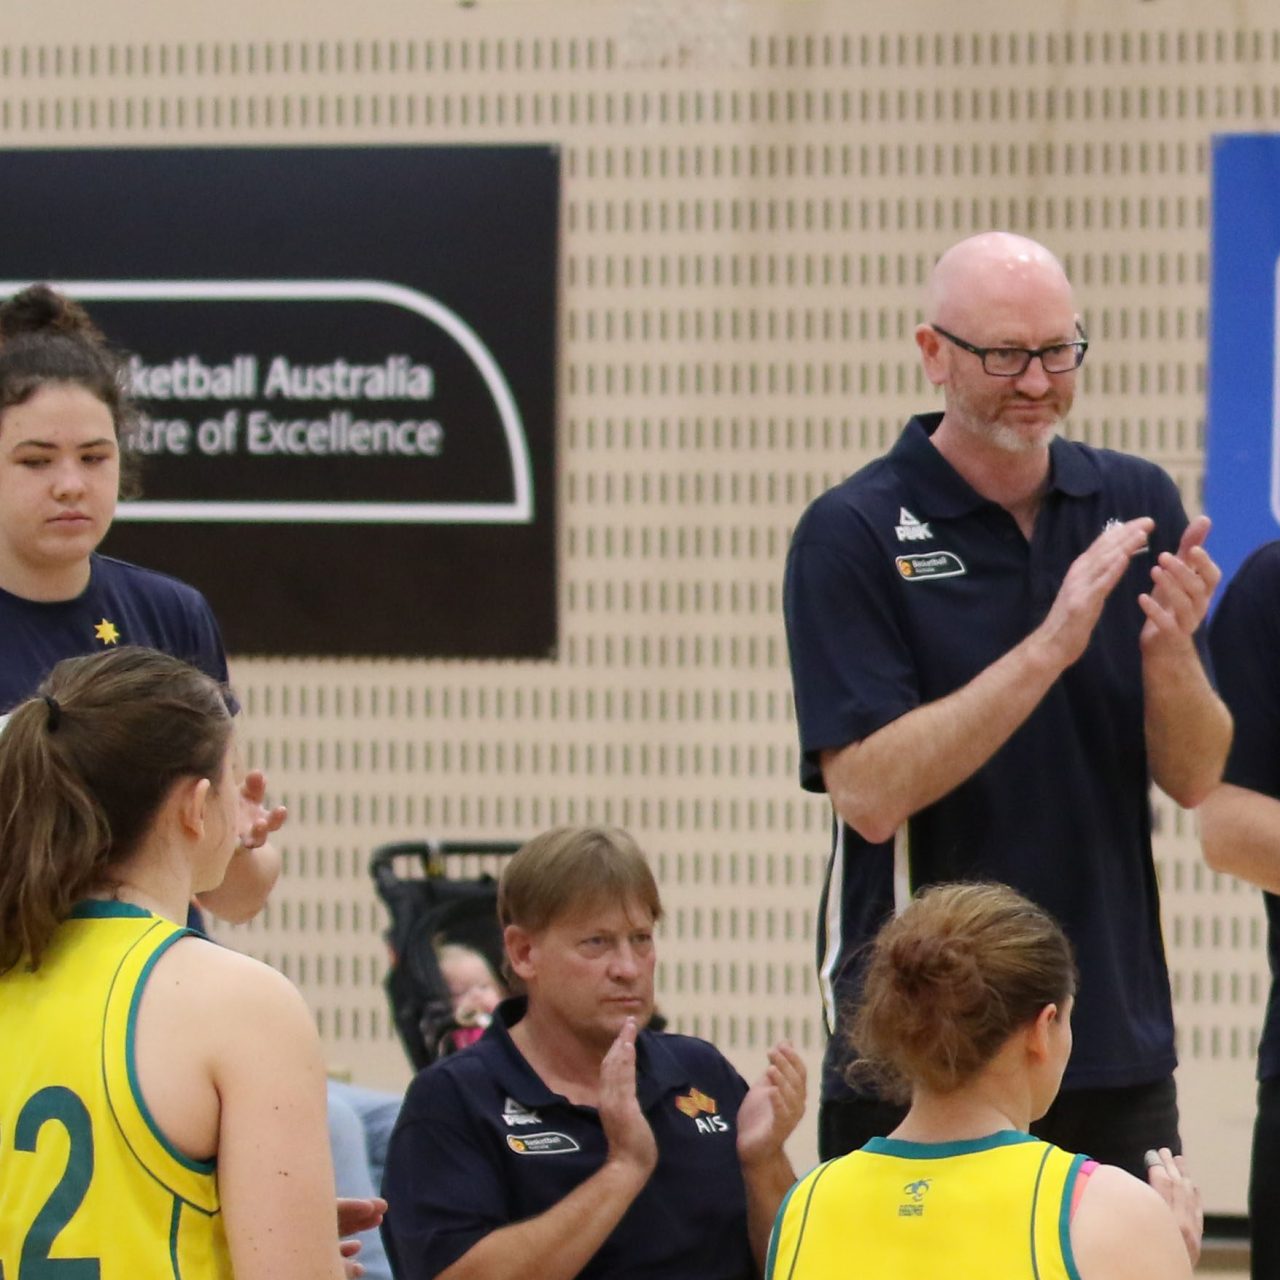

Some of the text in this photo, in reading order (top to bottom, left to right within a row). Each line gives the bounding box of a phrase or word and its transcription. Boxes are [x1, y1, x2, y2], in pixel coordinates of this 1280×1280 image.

[129, 354, 434, 398] ketball Australia
[138, 409, 442, 454] tre of Excellence
[695, 1116, 728, 1133] AIS
